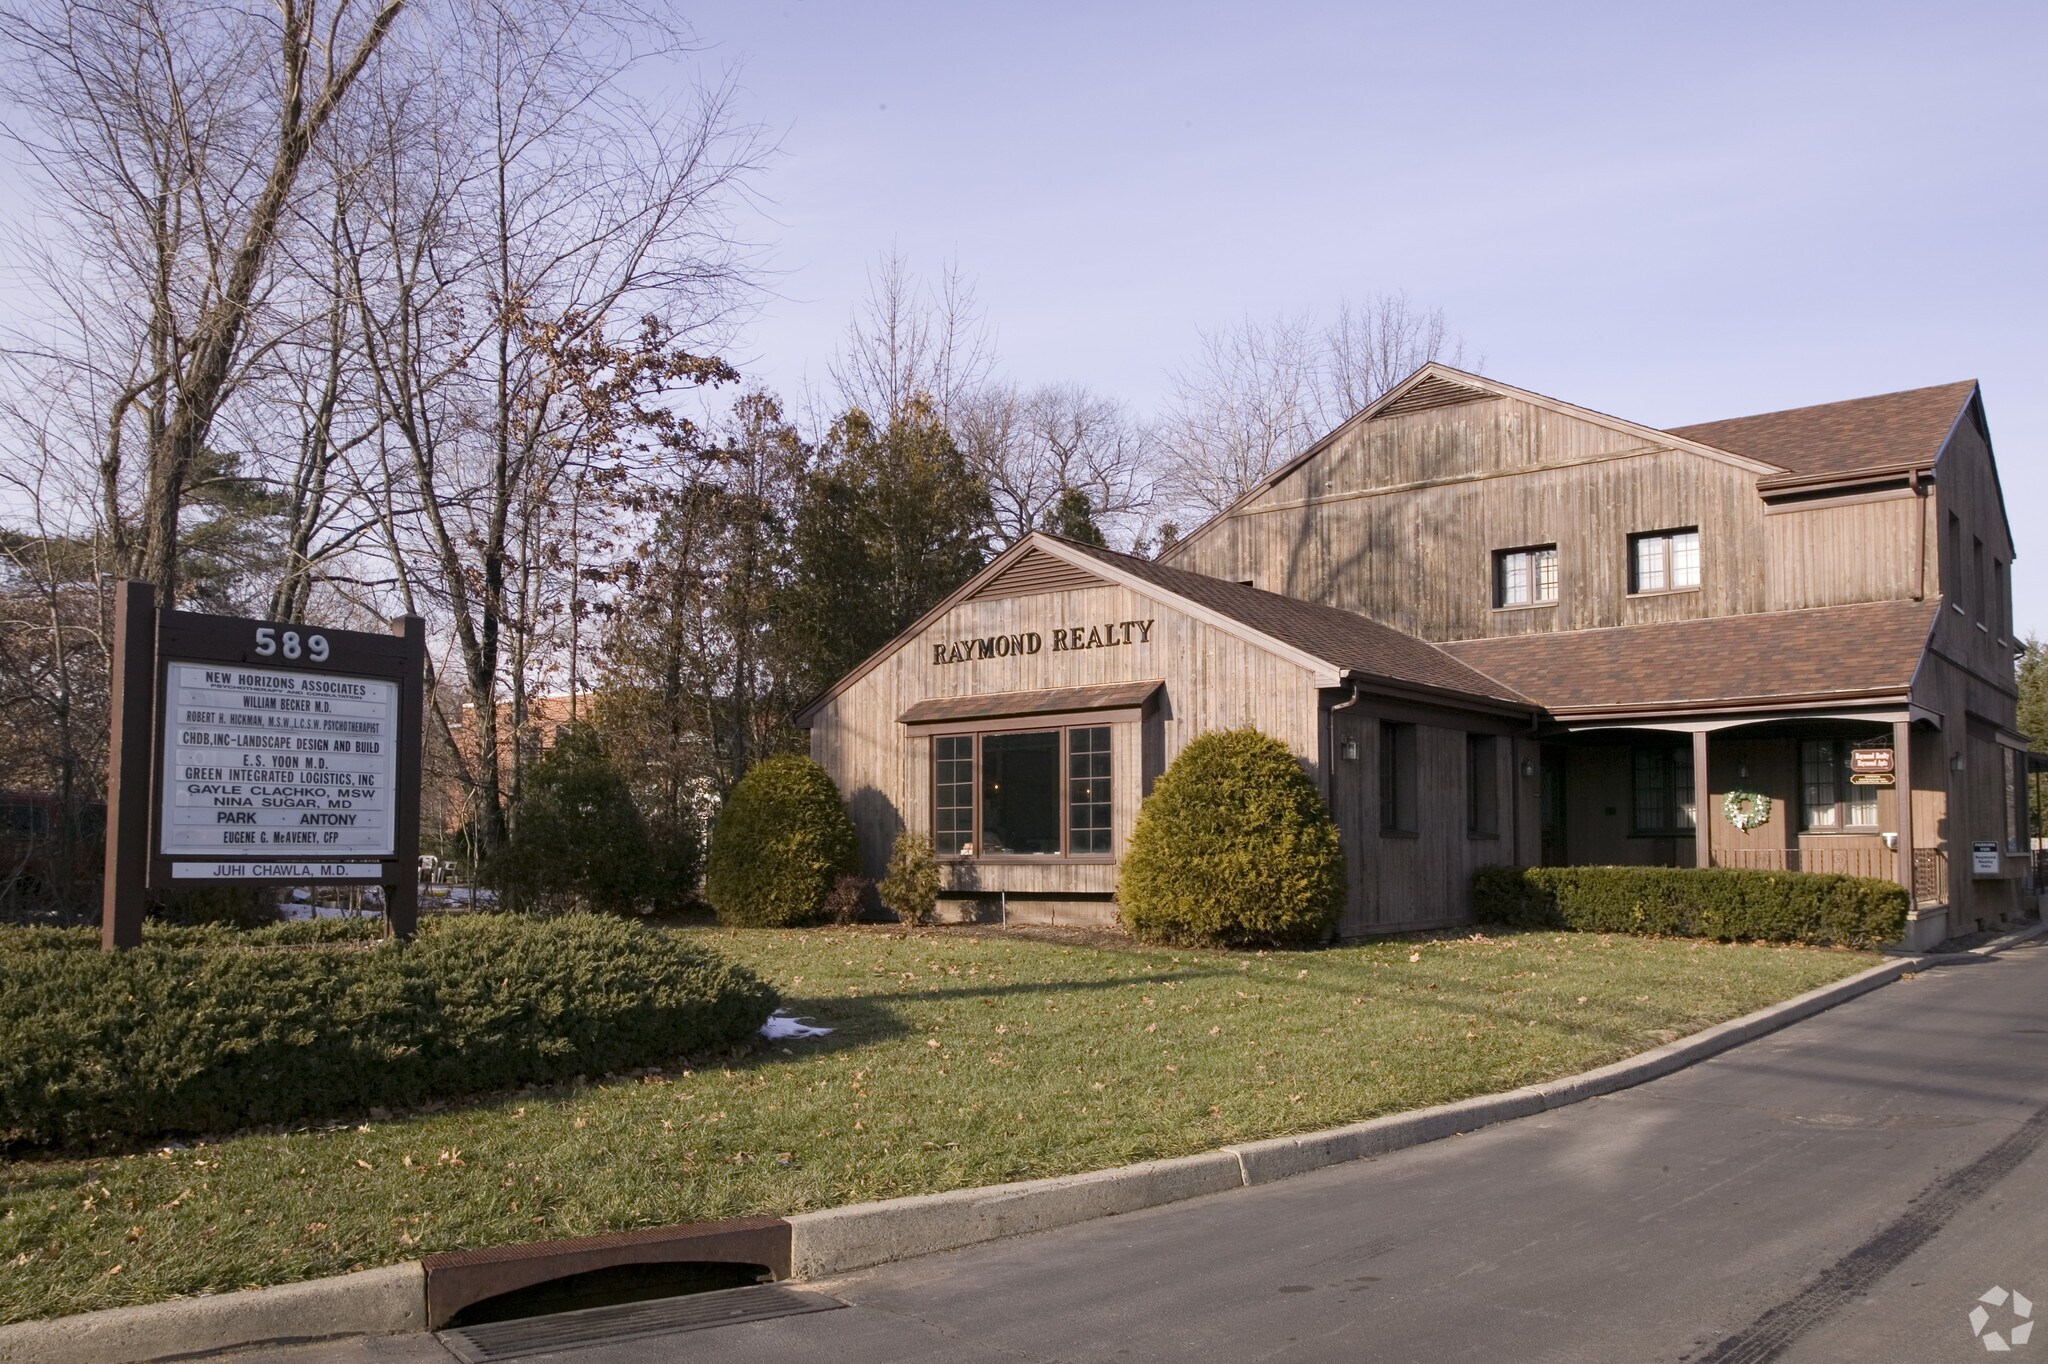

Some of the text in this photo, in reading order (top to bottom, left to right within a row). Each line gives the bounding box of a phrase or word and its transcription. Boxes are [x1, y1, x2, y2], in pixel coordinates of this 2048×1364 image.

[255, 627, 329, 662] 589
[932, 619, 1154, 665] RAYMOND REALTY
[206, 671, 366, 696] NEW HORIZONS ASSOCIATES
[210, 683, 283, 693] PSYCHOTHERAPY
[306, 691, 362, 700] CONSULTATION
[243, 695, 332, 713] WILLIAM BECKER M.D.
[186, 711, 215, 723] ROBERT
[219, 713, 226, 724] H.
[230, 713, 265, 727] HICKMAN,
[323, 719, 380, 734] PSYCHOTHERAPIST
[296, 738, 329, 751] DESIGN
[333, 740, 351, 752] AND
[355, 741, 380, 753] BUILD
[272, 755, 299, 768] YOON
[305, 757, 328, 769] M.D.
[185, 767, 375, 786] GREEN INTEGRATED LOGISTICS, INC
[187, 784, 375, 798] GAYLE CLACHKO, MSW
[214, 797, 353, 809] NINA SUGAR, MD
[217, 811, 357, 826] PARK ANTONY
[223, 831, 339, 844] EUGENE G. McAVENEY, CFP
[213, 865, 349, 877] JUHI CHAWLA, M.D.
